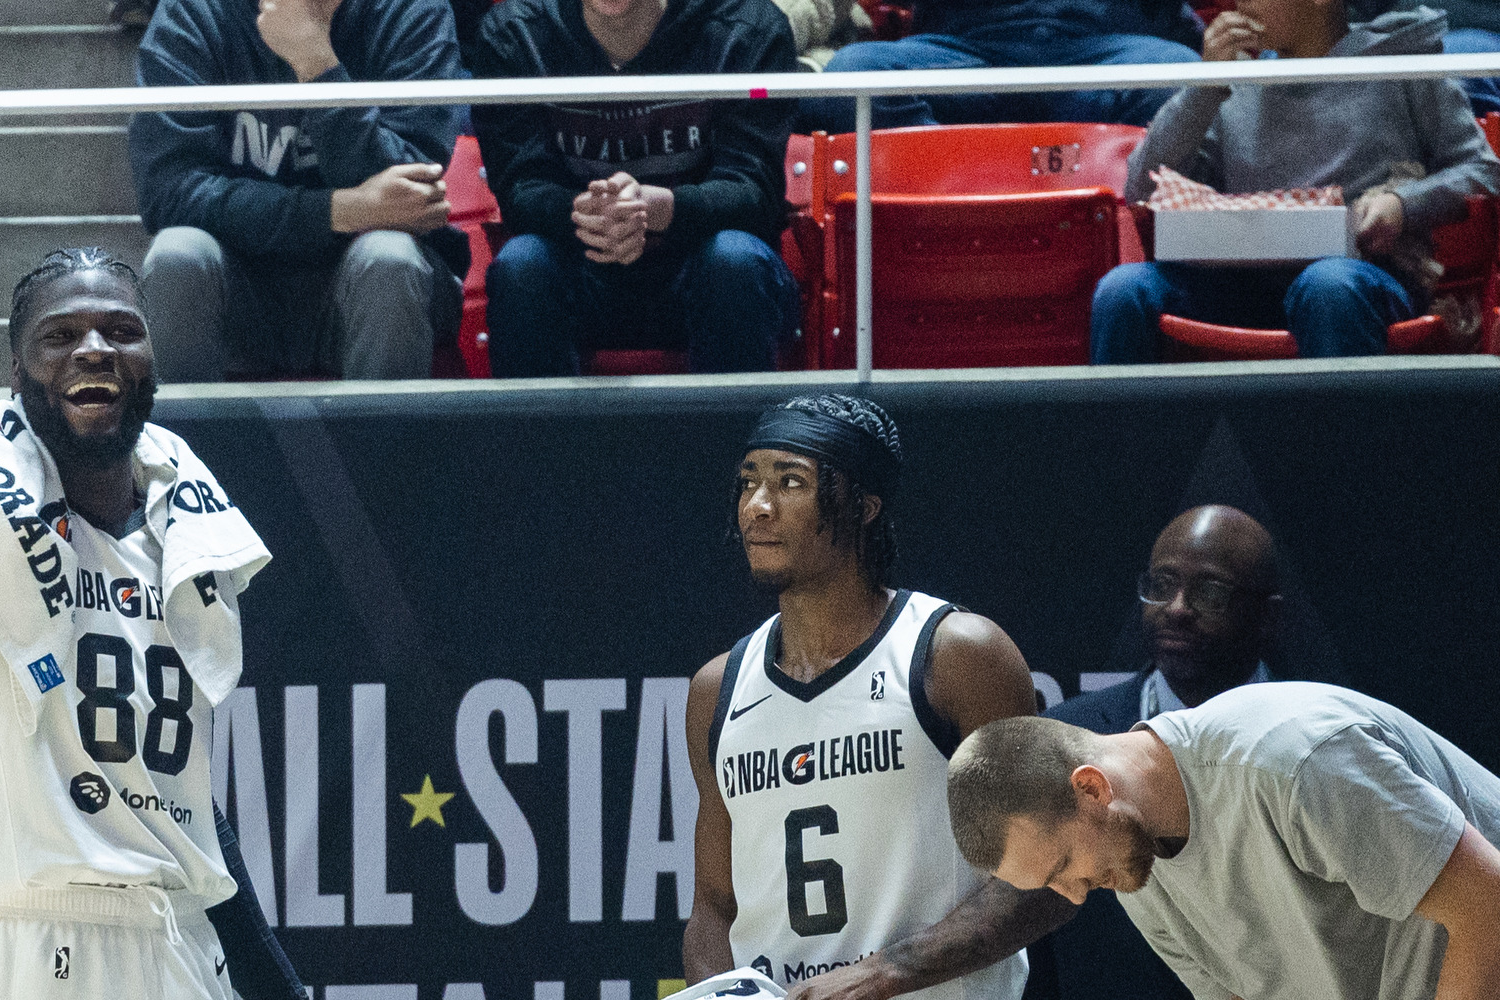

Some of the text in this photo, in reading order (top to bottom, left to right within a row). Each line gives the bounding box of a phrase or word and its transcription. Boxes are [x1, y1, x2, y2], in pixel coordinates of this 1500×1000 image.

[1048, 145, 1063, 173] 6
[76, 632, 194, 777] 88
[738, 748, 780, 796] NBA
[818, 728, 905, 782] LEAGUE
[783, 804, 848, 938] 6
